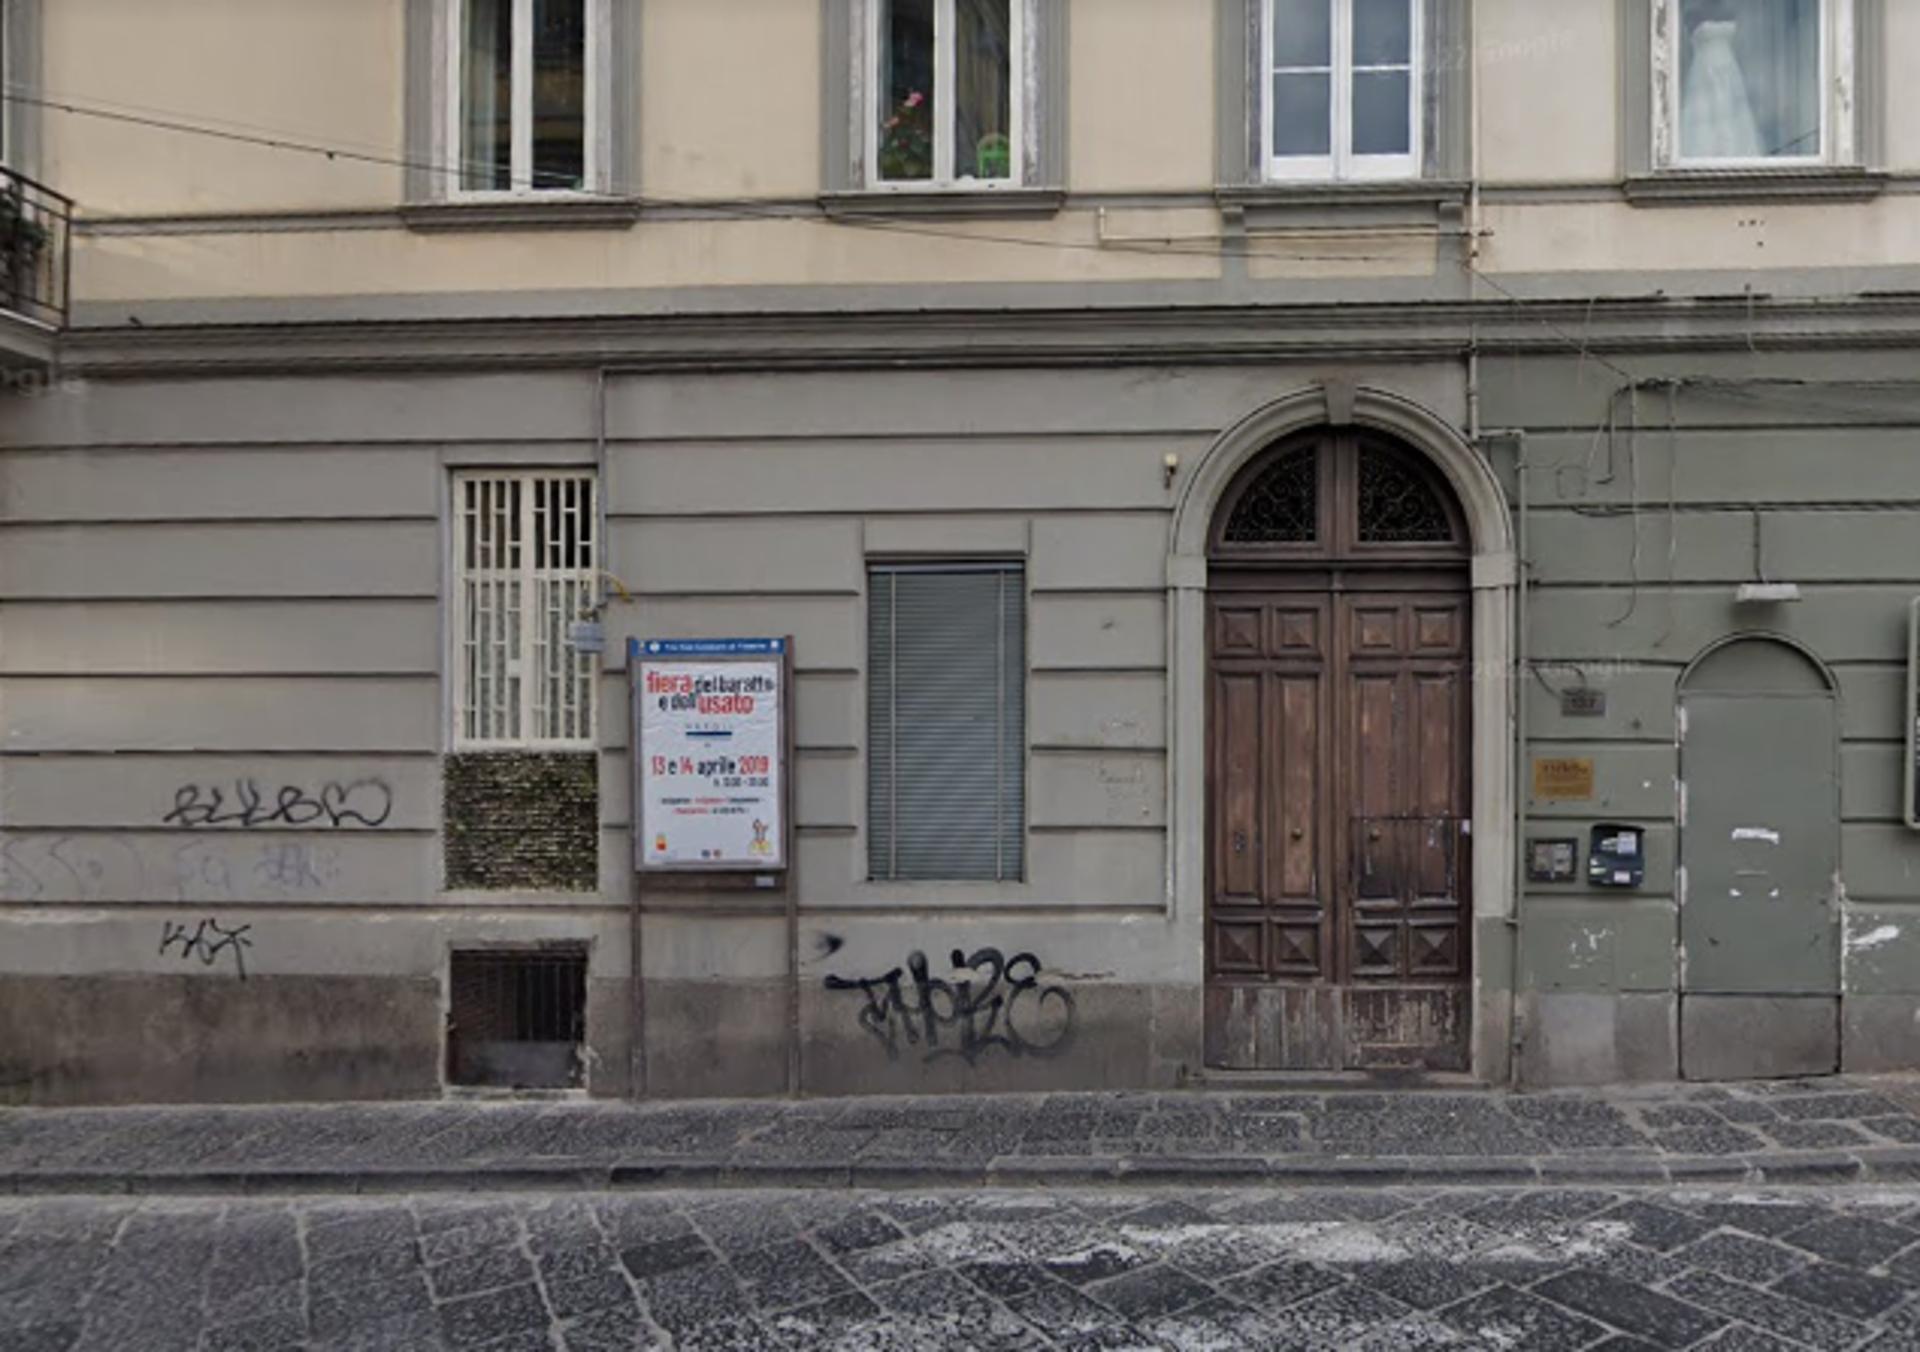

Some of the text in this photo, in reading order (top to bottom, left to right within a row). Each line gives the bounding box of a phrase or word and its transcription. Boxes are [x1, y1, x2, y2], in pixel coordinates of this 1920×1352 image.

[646, 672, 692, 693] fiera
[658, 696, 668, 710] e
[668, 760, 677, 775] e
[698, 756, 736, 777] aprile
